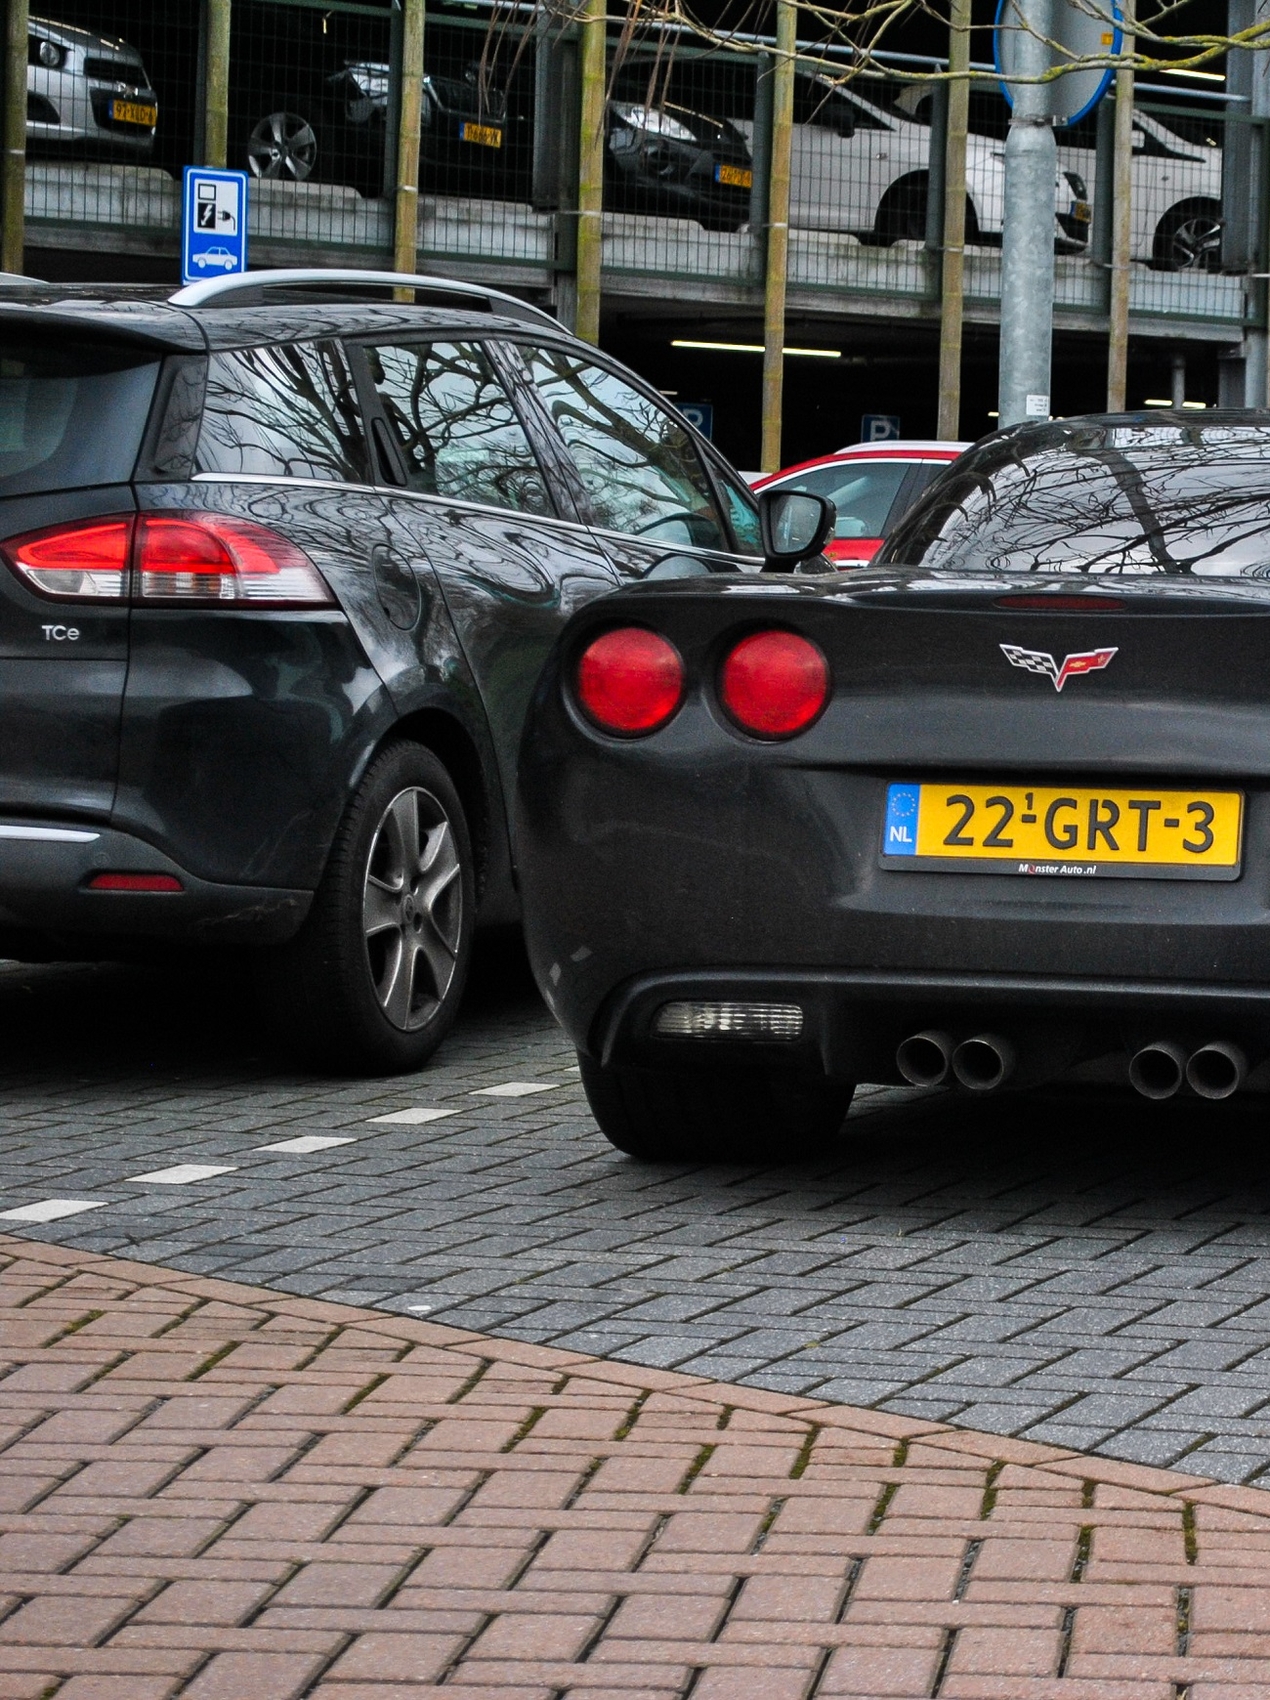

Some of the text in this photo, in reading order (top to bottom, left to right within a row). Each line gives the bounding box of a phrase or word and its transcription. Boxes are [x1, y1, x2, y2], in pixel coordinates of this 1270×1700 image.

[870, 420, 892, 441] P
[41, 624, 80, 641] TCe
[889, 826, 913, 844] NL
